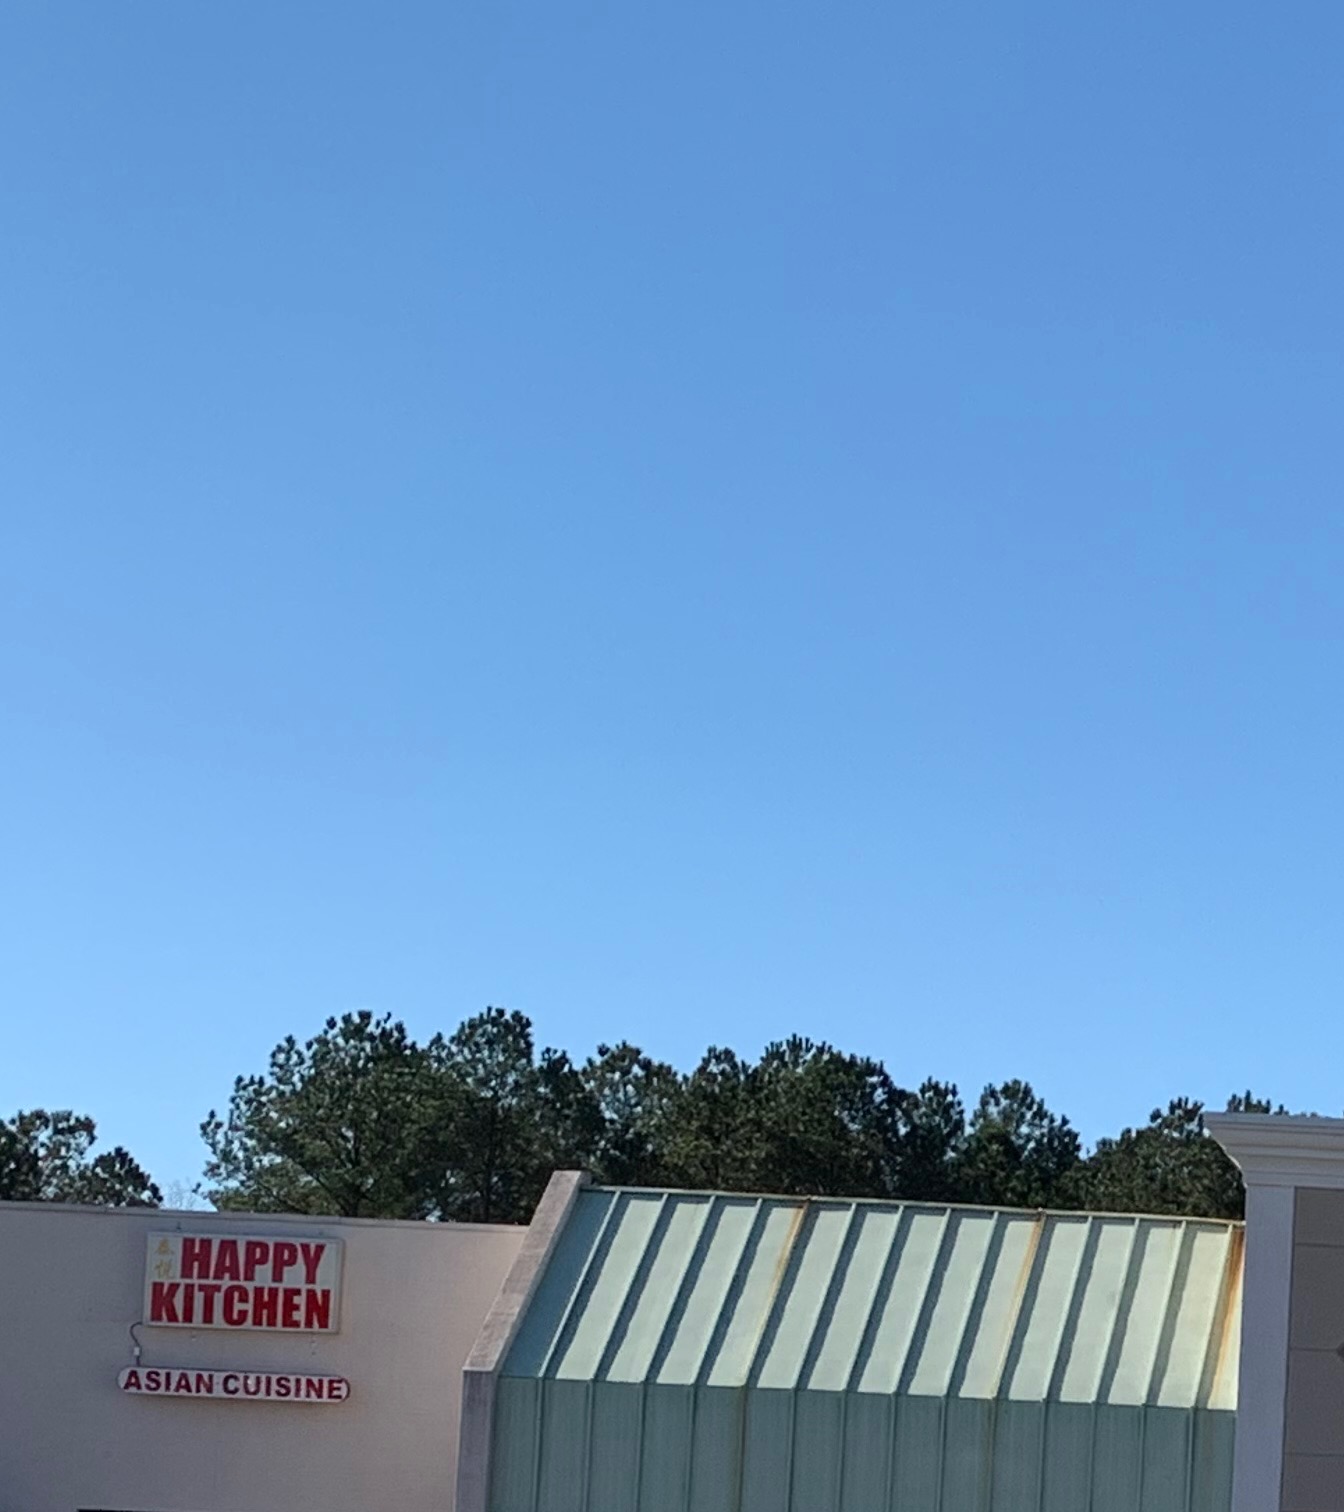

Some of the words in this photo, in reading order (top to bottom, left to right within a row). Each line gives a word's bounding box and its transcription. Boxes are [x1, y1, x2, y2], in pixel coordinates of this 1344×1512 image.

[180, 1237, 326, 1284] HAPPY
[150, 1281, 331, 1329] KITCHEN
[123, 1369, 214, 1394] ASIAN
[222, 1374, 345, 1400] CUISINE
